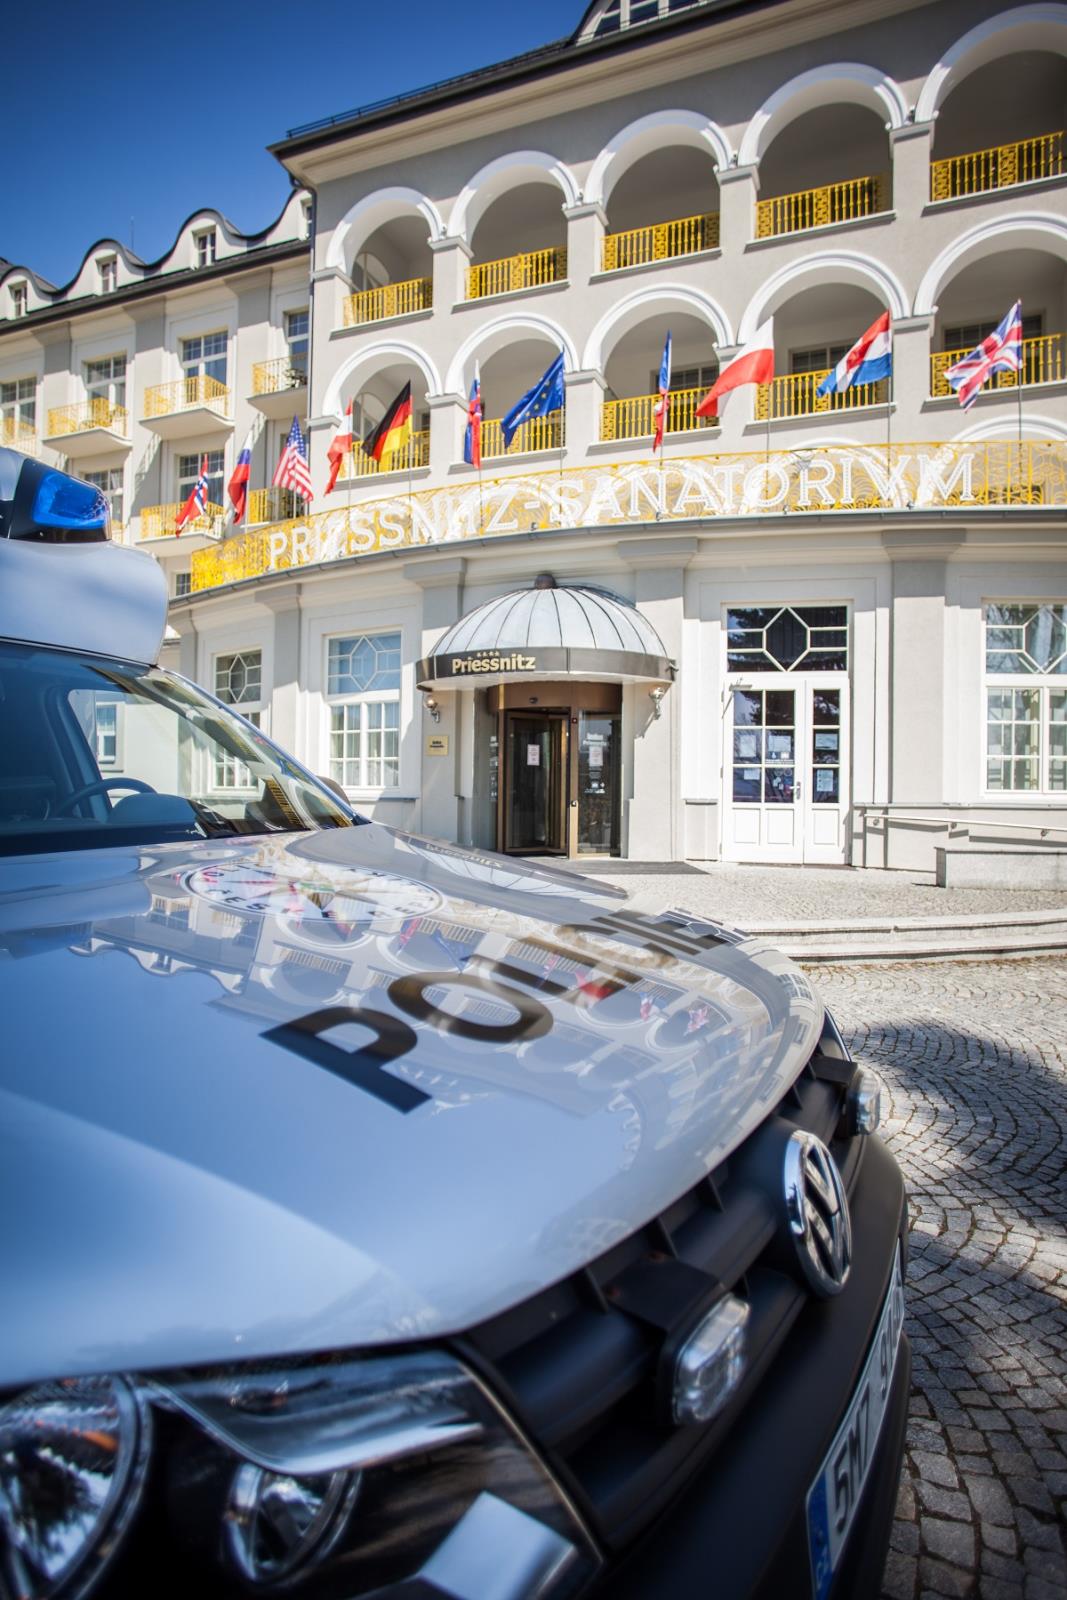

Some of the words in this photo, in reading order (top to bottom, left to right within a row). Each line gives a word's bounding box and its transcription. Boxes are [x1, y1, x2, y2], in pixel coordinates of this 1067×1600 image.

[451, 654, 537, 674] Priessnitz
[259, 909, 731, 1115] POLICIE
[832, 1381, 871, 1534] 5M7
